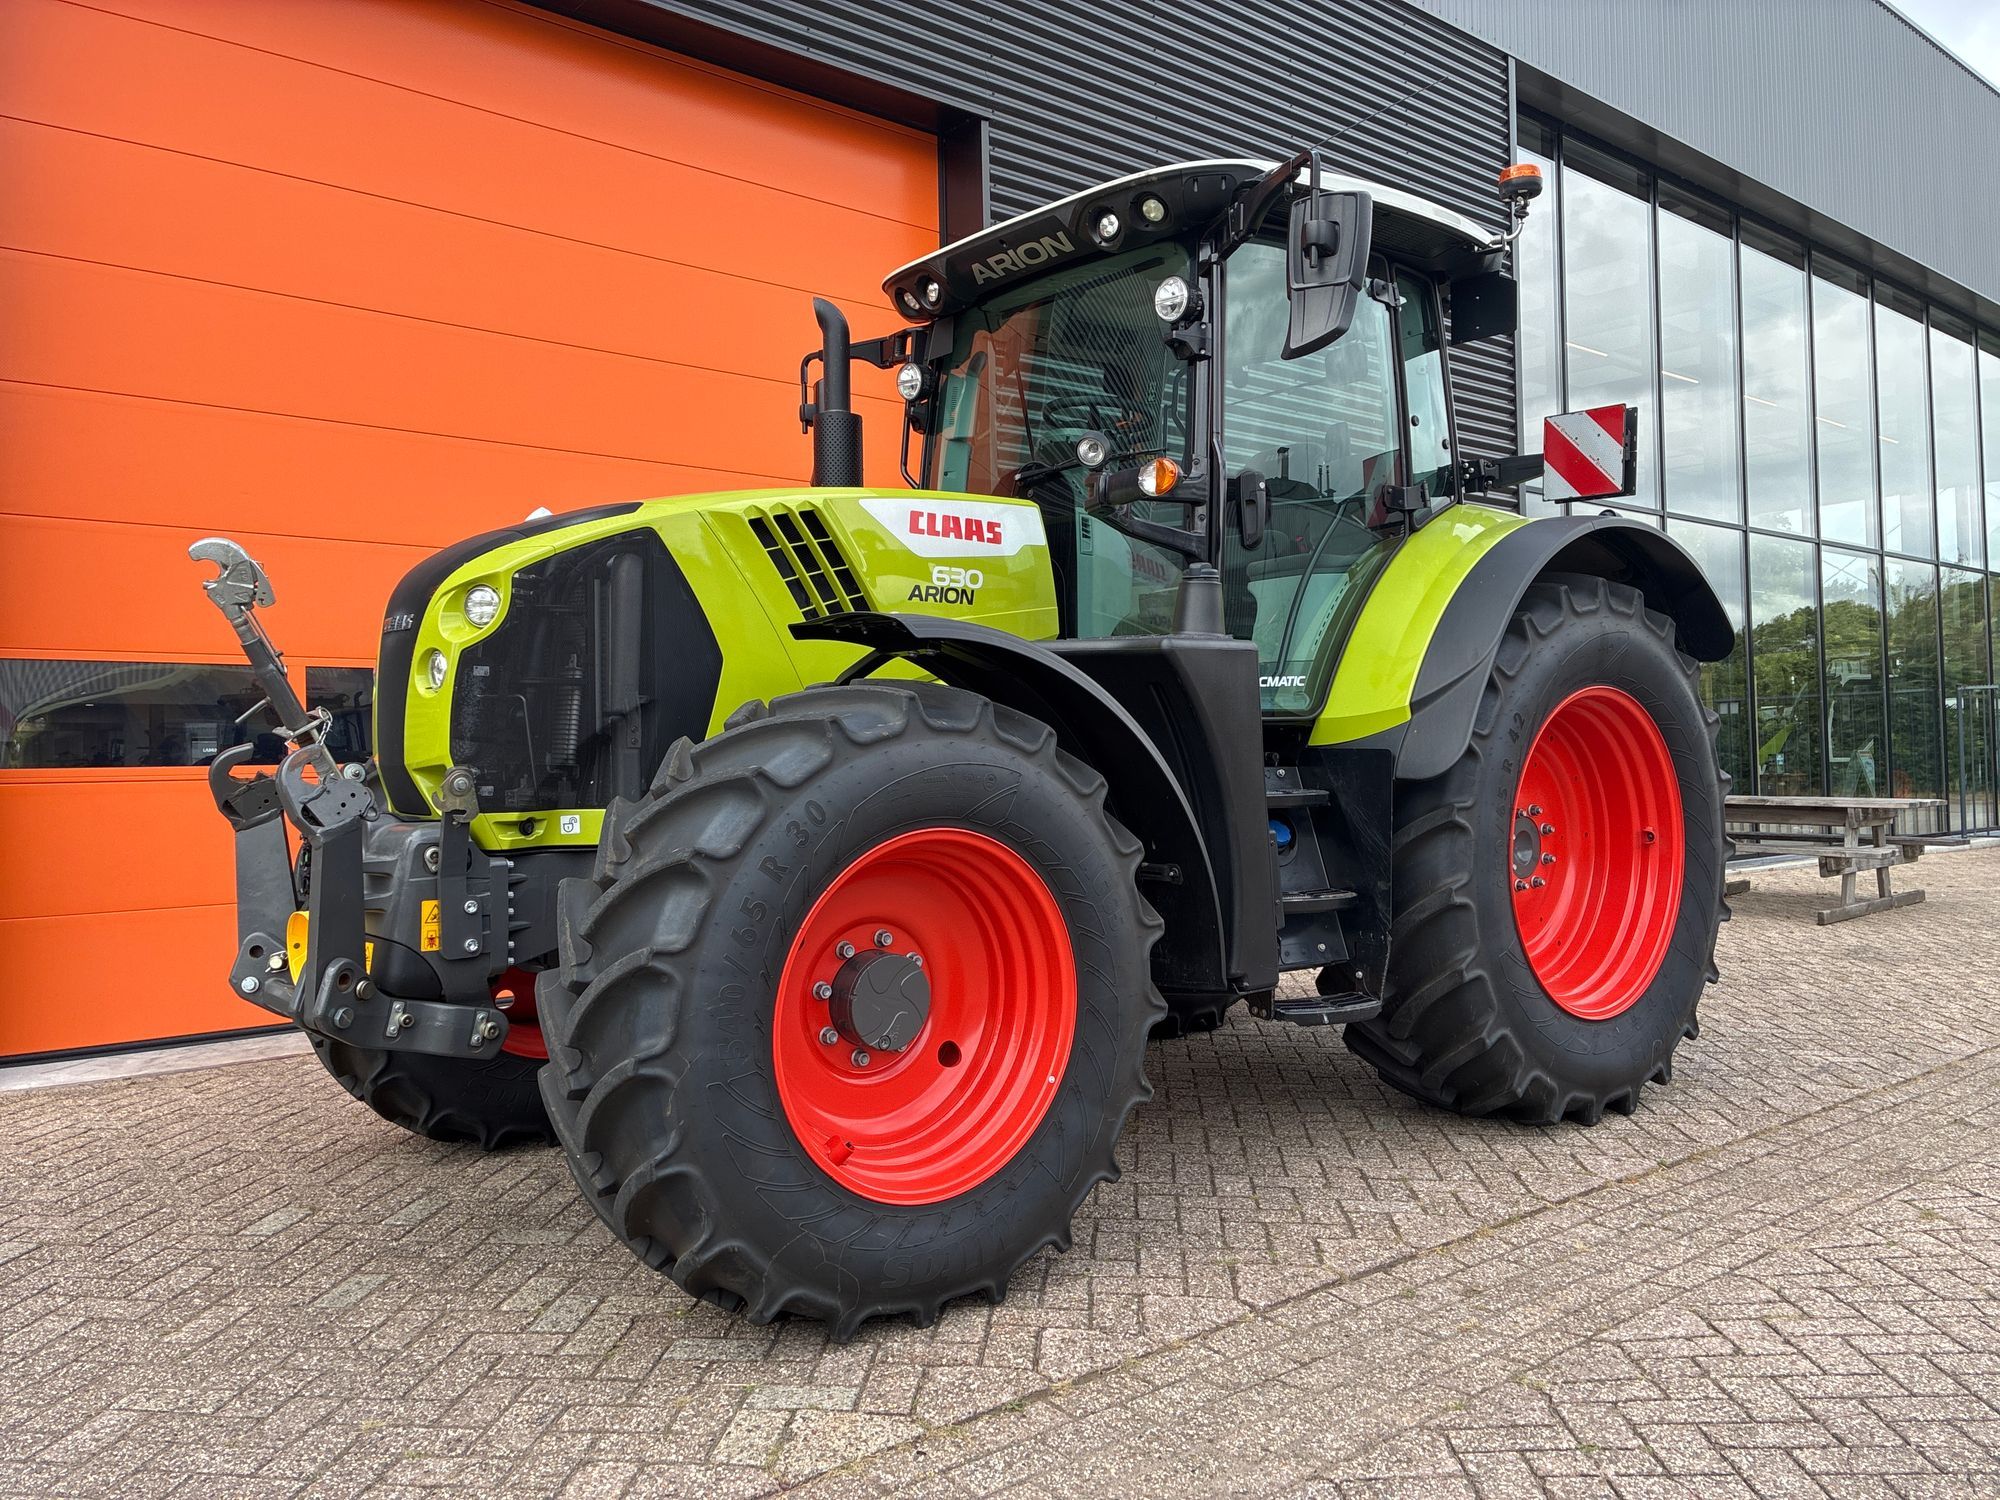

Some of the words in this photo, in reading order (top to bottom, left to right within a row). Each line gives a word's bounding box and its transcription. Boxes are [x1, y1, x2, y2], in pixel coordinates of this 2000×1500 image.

[971, 231, 1075, 285] ARION
[909, 510, 1002, 545] CLAAS
[932, 566, 984, 589] 630
[908, 584, 975, 605] ARION
[1259, 675, 1306, 687] CMATIC
[1507, 711, 1526, 745] 42
[1502, 758, 1514, 774] R
[717, 896, 768, 1061] 540/65
[757, 855, 790, 884] R
[785, 800, 826, 848] 30
